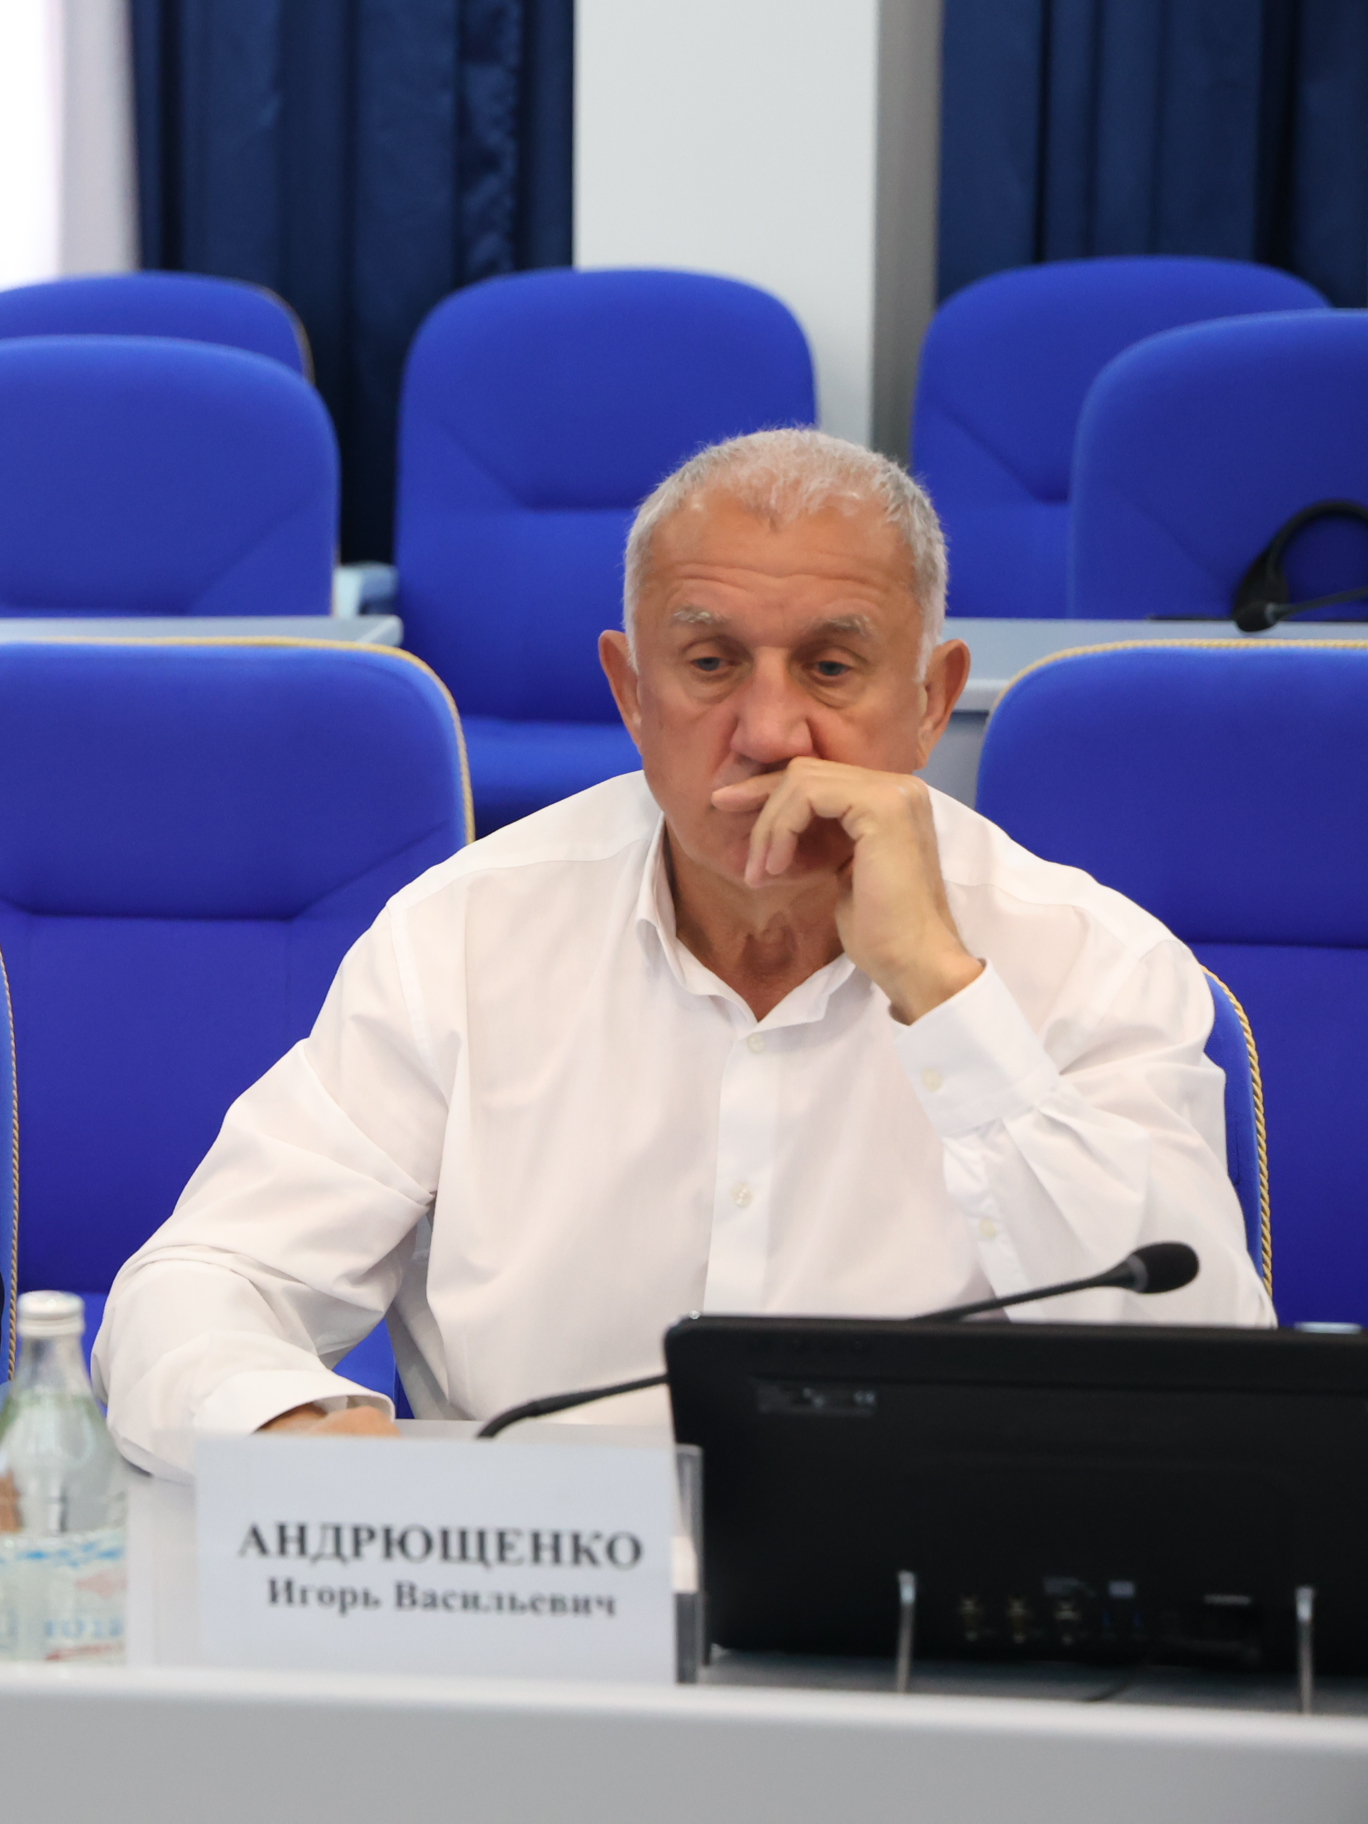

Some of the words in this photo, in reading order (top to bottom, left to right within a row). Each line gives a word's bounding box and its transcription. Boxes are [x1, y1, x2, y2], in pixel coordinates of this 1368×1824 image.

[238, 1522, 644, 1570] АНДРЮЩЕНКО
[267, 1577, 381, 1617] Игорь
[394, 1580, 616, 1617] Васильевич
